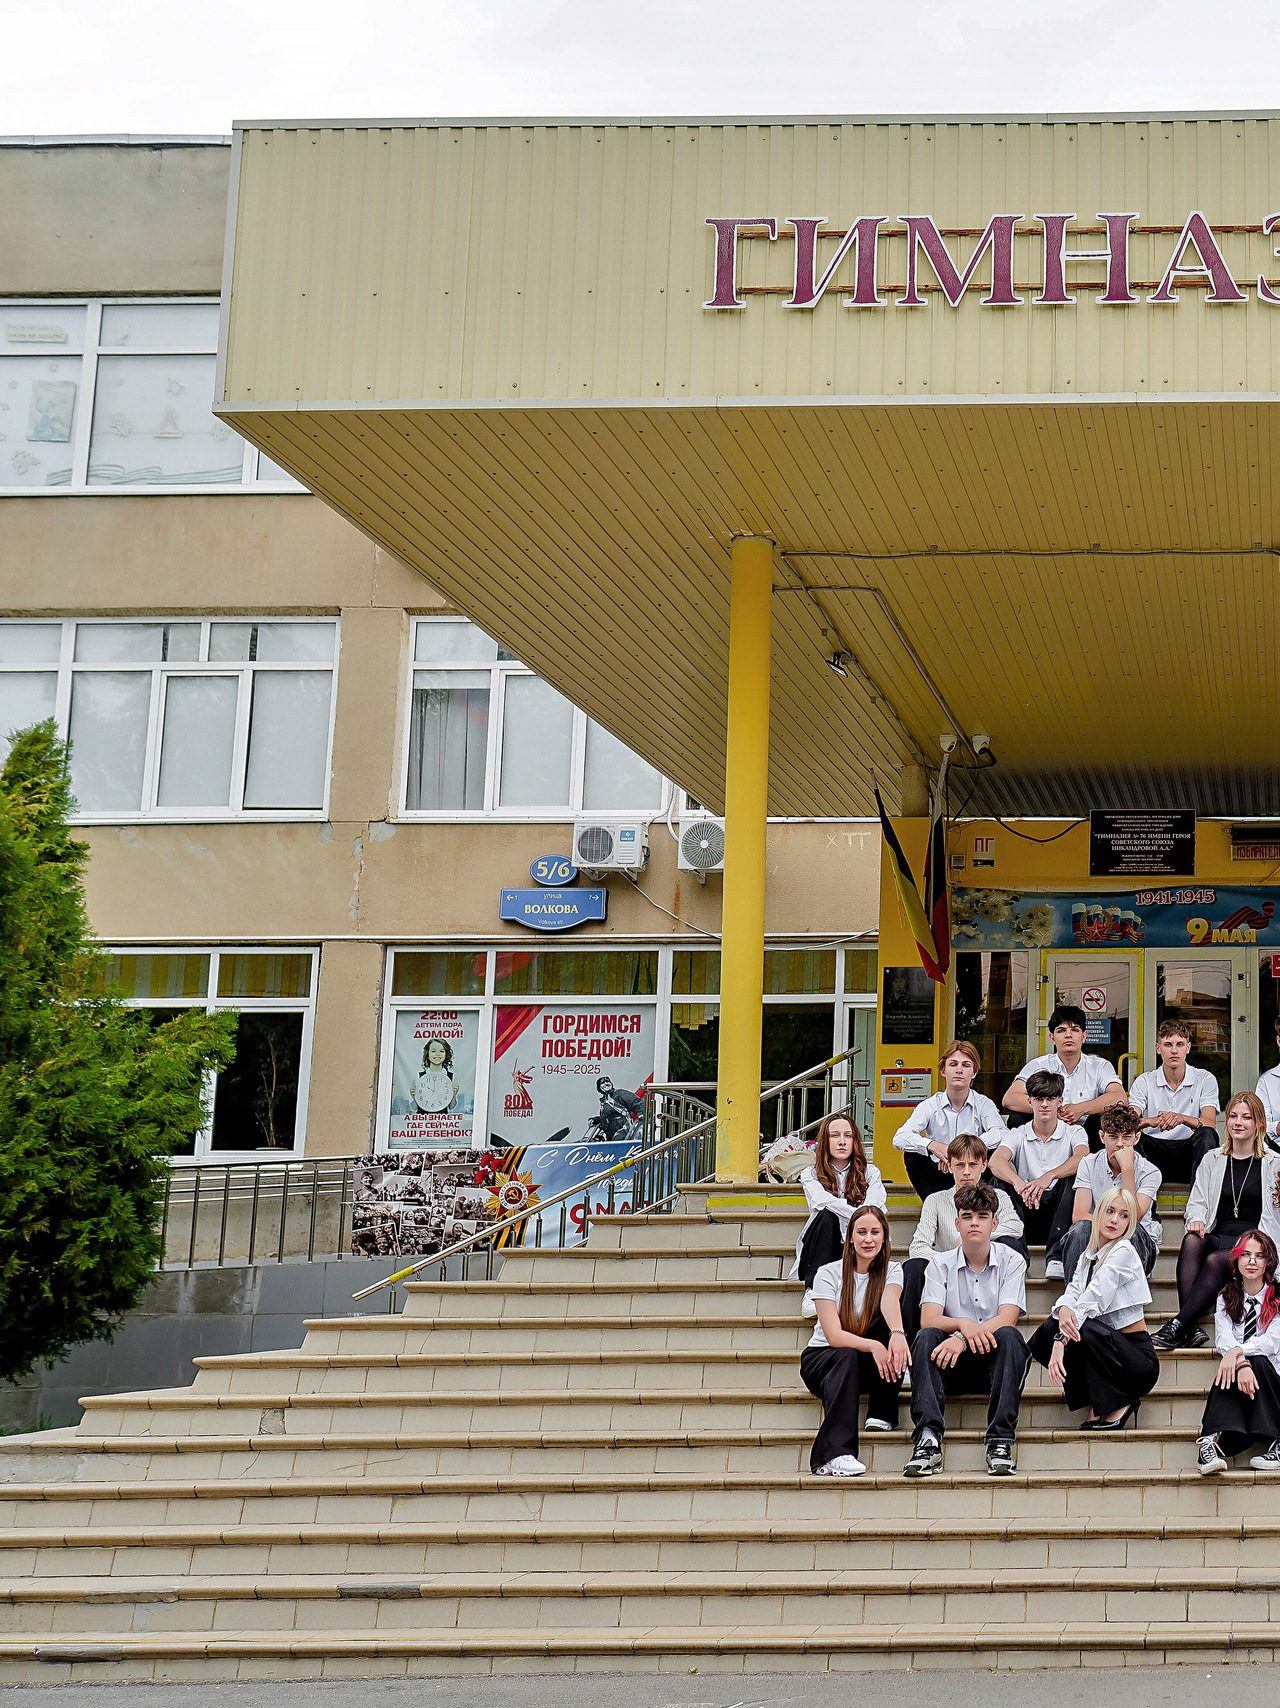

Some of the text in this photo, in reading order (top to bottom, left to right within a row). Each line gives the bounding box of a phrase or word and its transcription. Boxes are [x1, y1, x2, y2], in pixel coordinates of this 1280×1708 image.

[974, 838, 994, 852] ПГ
[536, 862, 570, 879] 5/6
[1136, 890, 1215, 905] 1941-1945
[524, 905, 578, 914] ВОЛКОВА
[1186, 917, 1256, 944] 9 МАЯ
[420, 1011, 458, 1020] 22:00
[542, 1014, 641, 1036] ГОРДИМСЯ
[413, 1028, 463, 1039] ДОМОЙ!
[541, 1037, 631, 1060] ПОБЕДОЙ!
[504, 1094, 520, 1107] 80
[419, 1129, 473, 1138] РЕБЕНОК?
[536, 1149, 558, 1169] С
[564, 1146, 615, 1166] Днём
